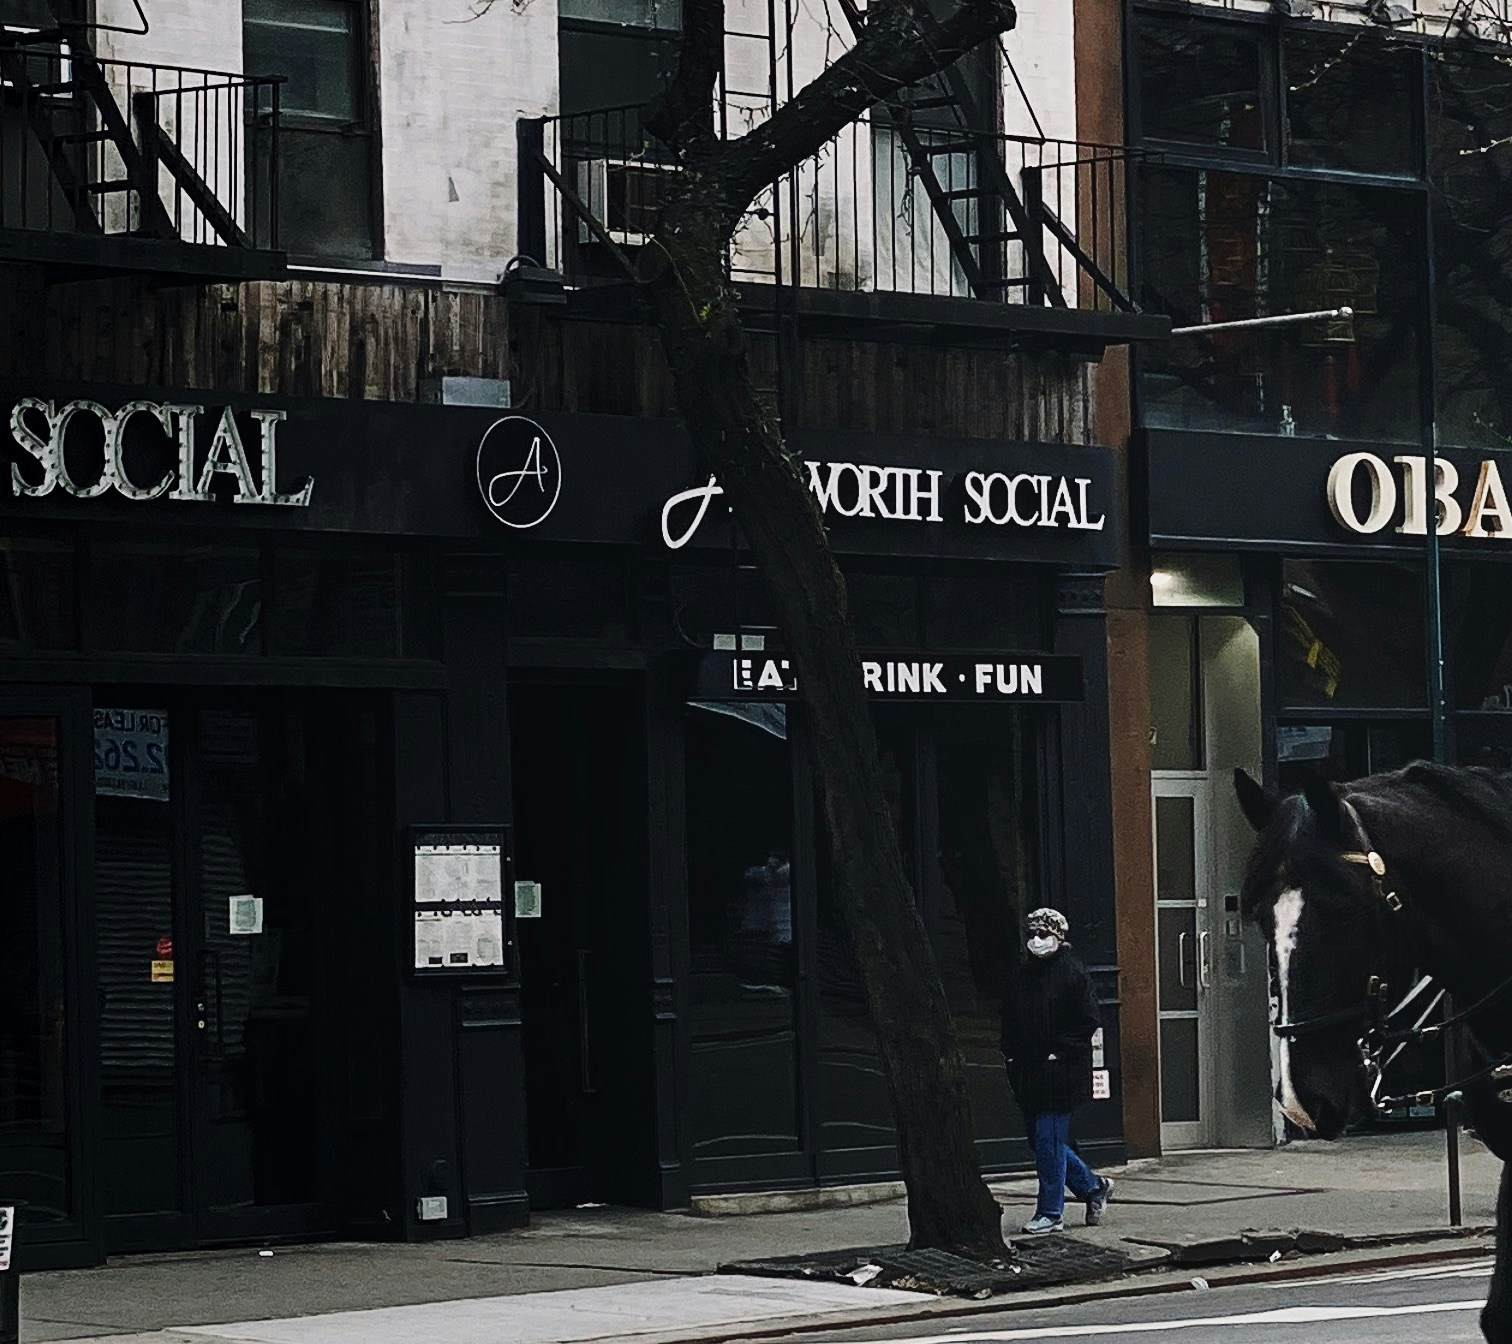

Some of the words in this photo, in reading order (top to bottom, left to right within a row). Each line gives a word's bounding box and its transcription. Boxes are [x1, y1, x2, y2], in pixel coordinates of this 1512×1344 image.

[10, 397, 314, 507] SOCIAL
[964, 472, 1105, 530] SOCIAL
[862, 662, 947, 693] RINK
[975, 664, 1043, 694] FUN
